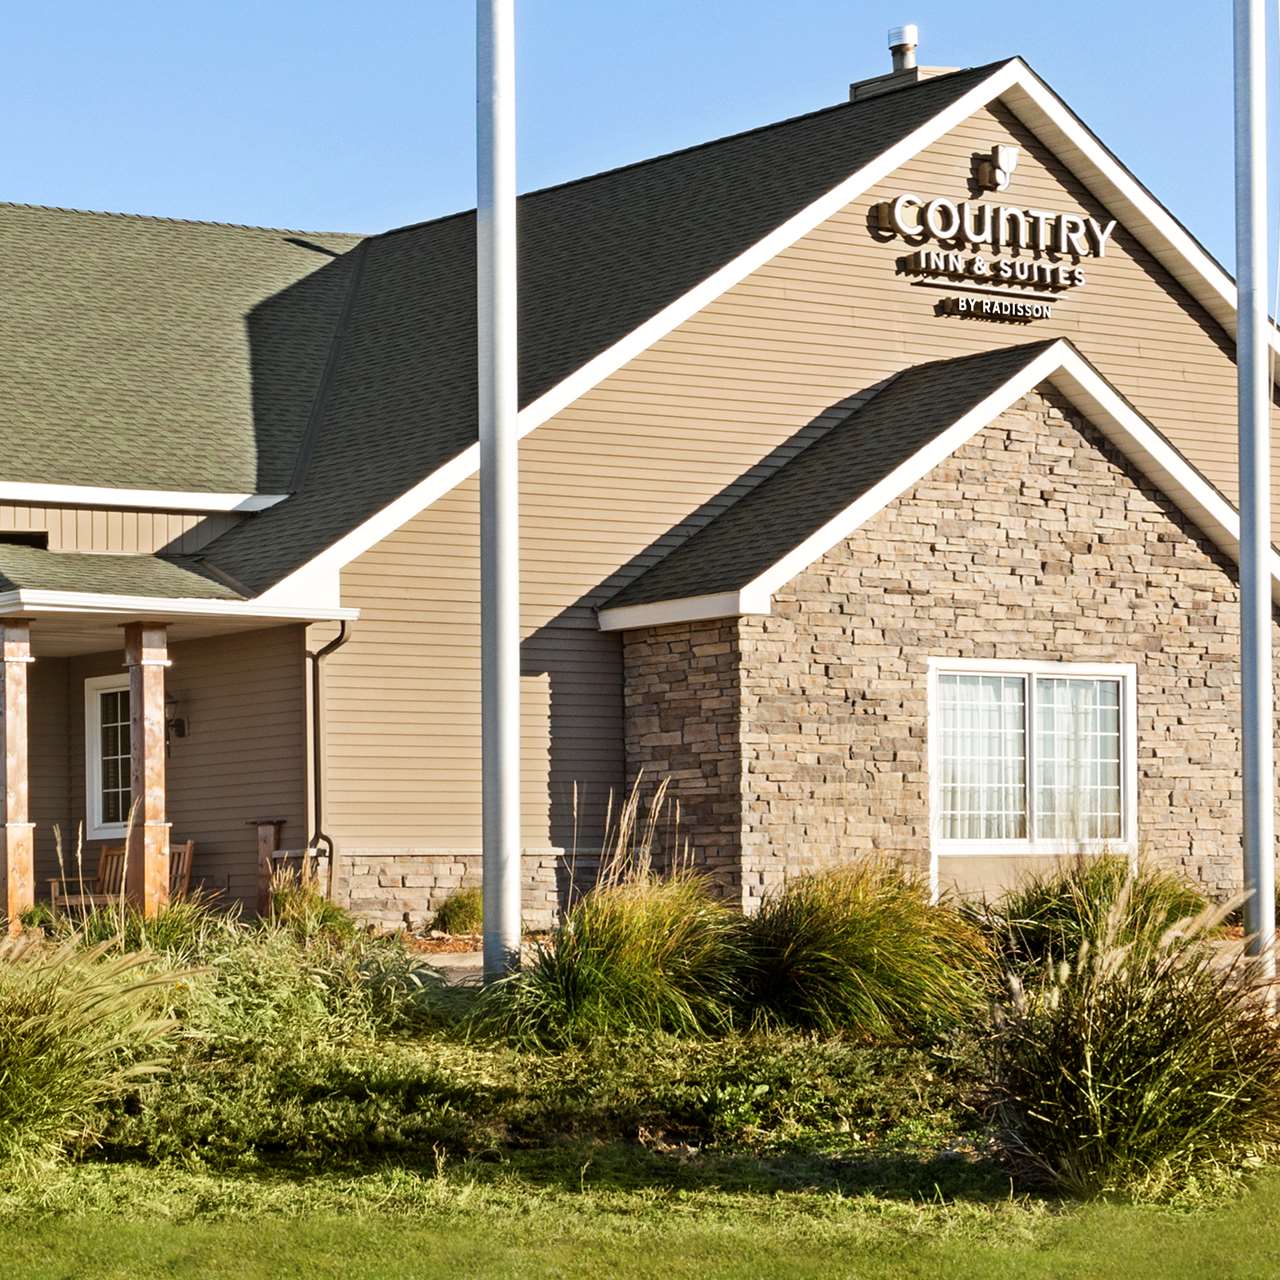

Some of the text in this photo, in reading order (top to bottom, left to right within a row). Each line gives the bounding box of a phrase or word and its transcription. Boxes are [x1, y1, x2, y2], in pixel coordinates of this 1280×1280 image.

[920, 250, 1087, 287] INN & SUITES
[958, 297, 1053, 319] BY RADISSON
